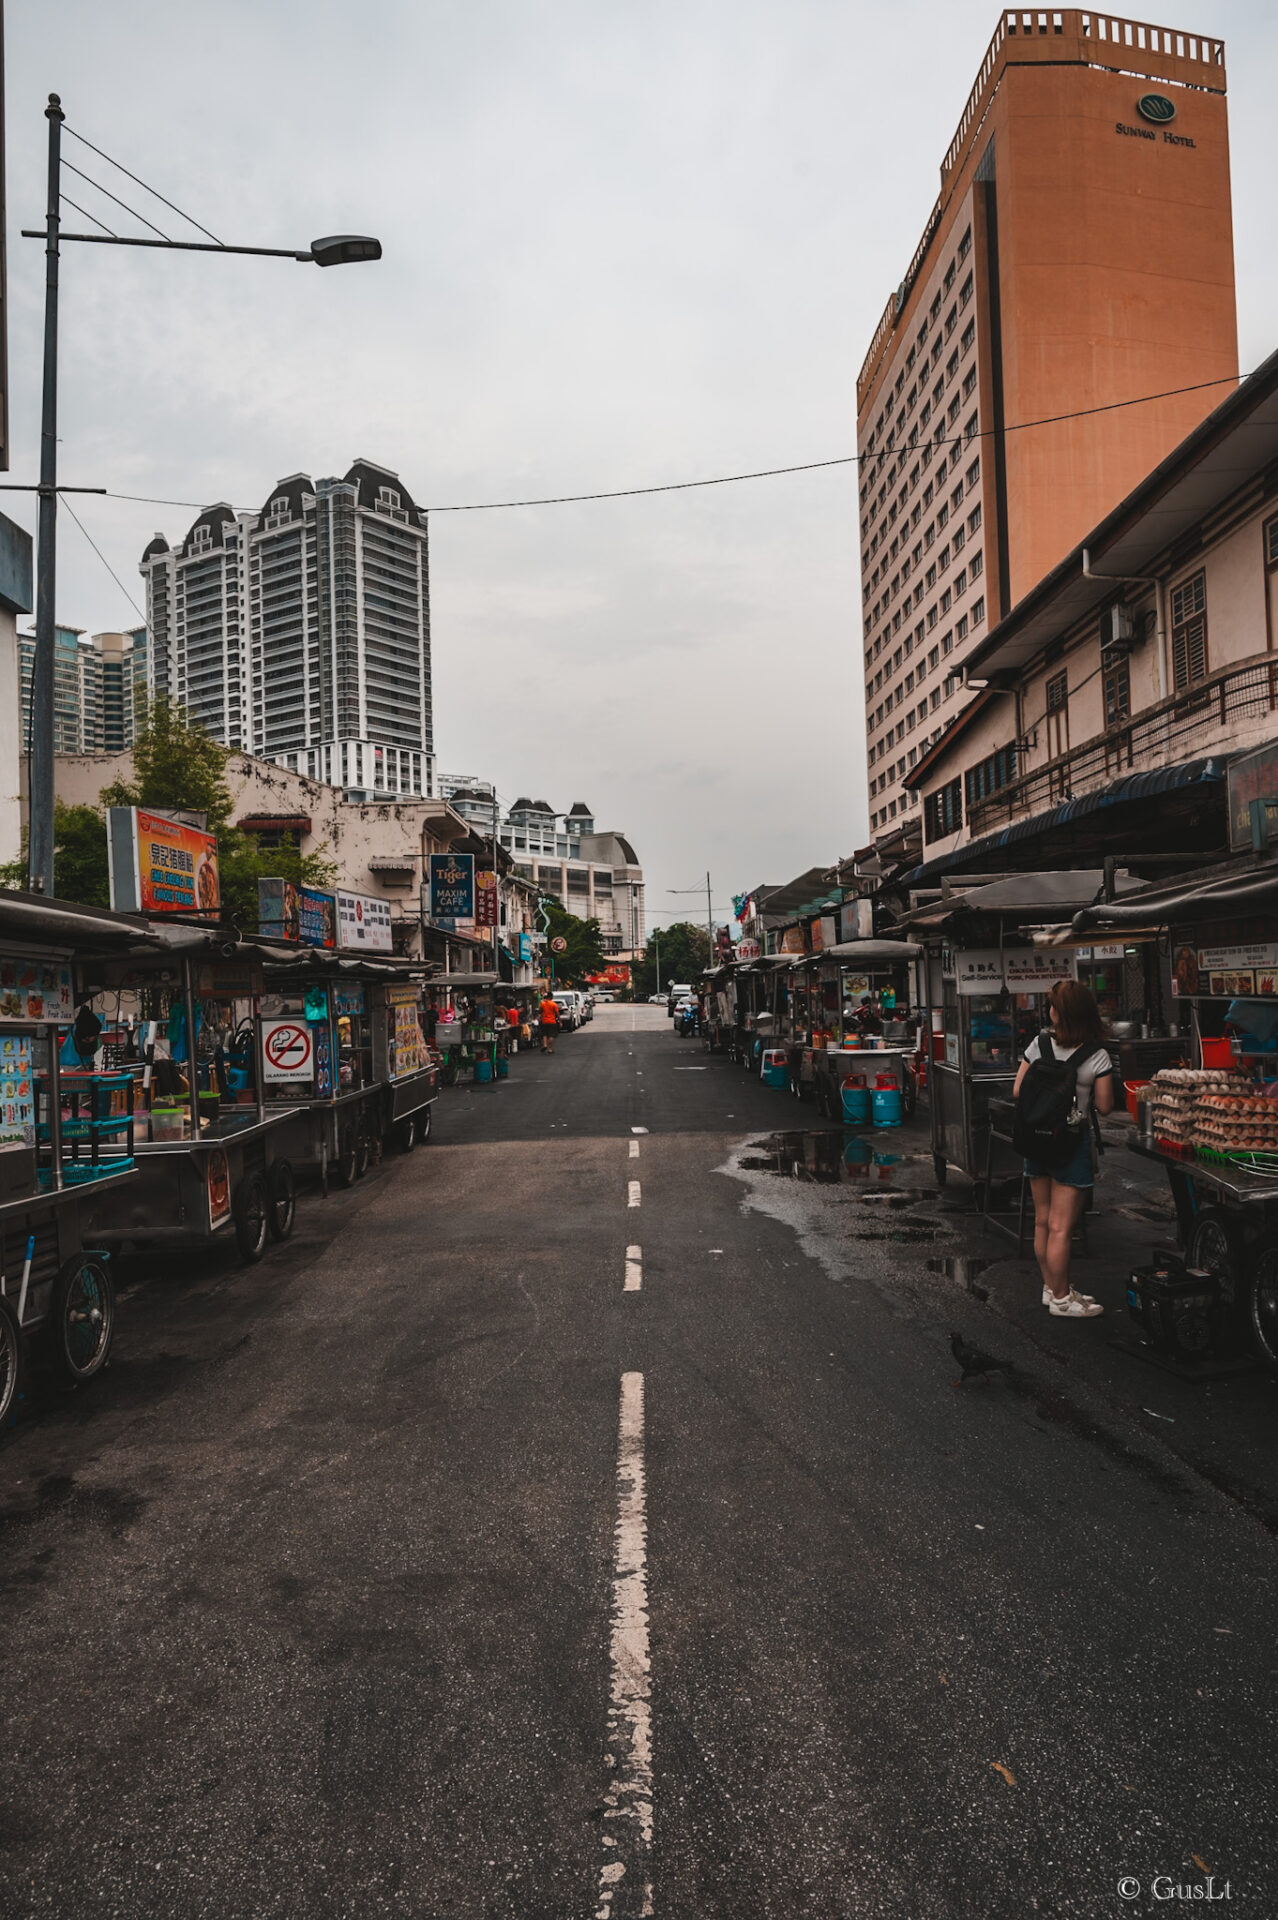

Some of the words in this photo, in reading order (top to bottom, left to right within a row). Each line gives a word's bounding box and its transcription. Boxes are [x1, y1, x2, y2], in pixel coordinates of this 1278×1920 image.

[1163, 131, 1197, 149] HOTEL
[436, 868, 468, 884] Tiger
[436, 889, 467, 898] MAXIM
[439, 897, 464, 906] CAFE
